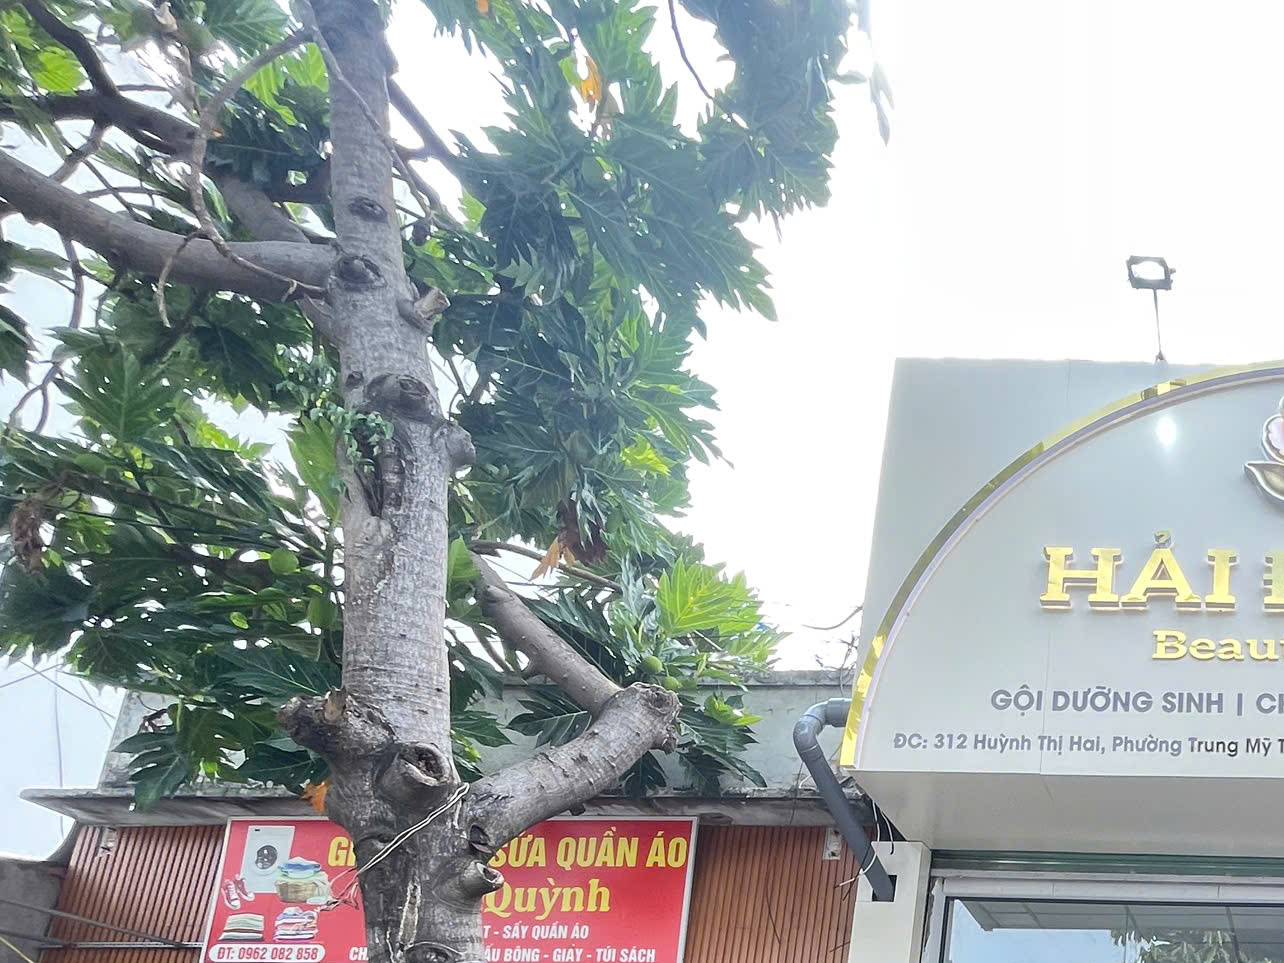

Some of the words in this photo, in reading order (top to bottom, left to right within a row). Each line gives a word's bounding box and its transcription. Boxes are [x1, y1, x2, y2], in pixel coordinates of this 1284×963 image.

[1039, 530, 1238, 610] HẢI
[991, 684, 1043, 716] GỘI
[1052, 686, 1154, 713] DƯỠNG
[1161, 691, 1224, 714] SINH
[893, 733, 928, 750] ĐC:
[933, 733, 968, 750] 312
[973, 734, 1032, 754] Huỳnh
[1038, 735, 1063, 756] Thị
[1069, 736, 1106, 755] Hai,
[1112, 734, 1182, 757] Phường
[1188, 737, 1239, 757] Trung
[1246, 738, 1272, 757] Mỹ
[556, 827, 639, 871] QUẦN
[646, 831, 688, 868] ÁO
[571, 923, 590, 940] ÁO
[238, 947, 268, 961] 0962
[271, 947, 292, 961] 082
[503, 945, 541, 963] BÔNG
[595, 945, 617, 962] TÚI
[619, 943, 656, 963] SÁCH
